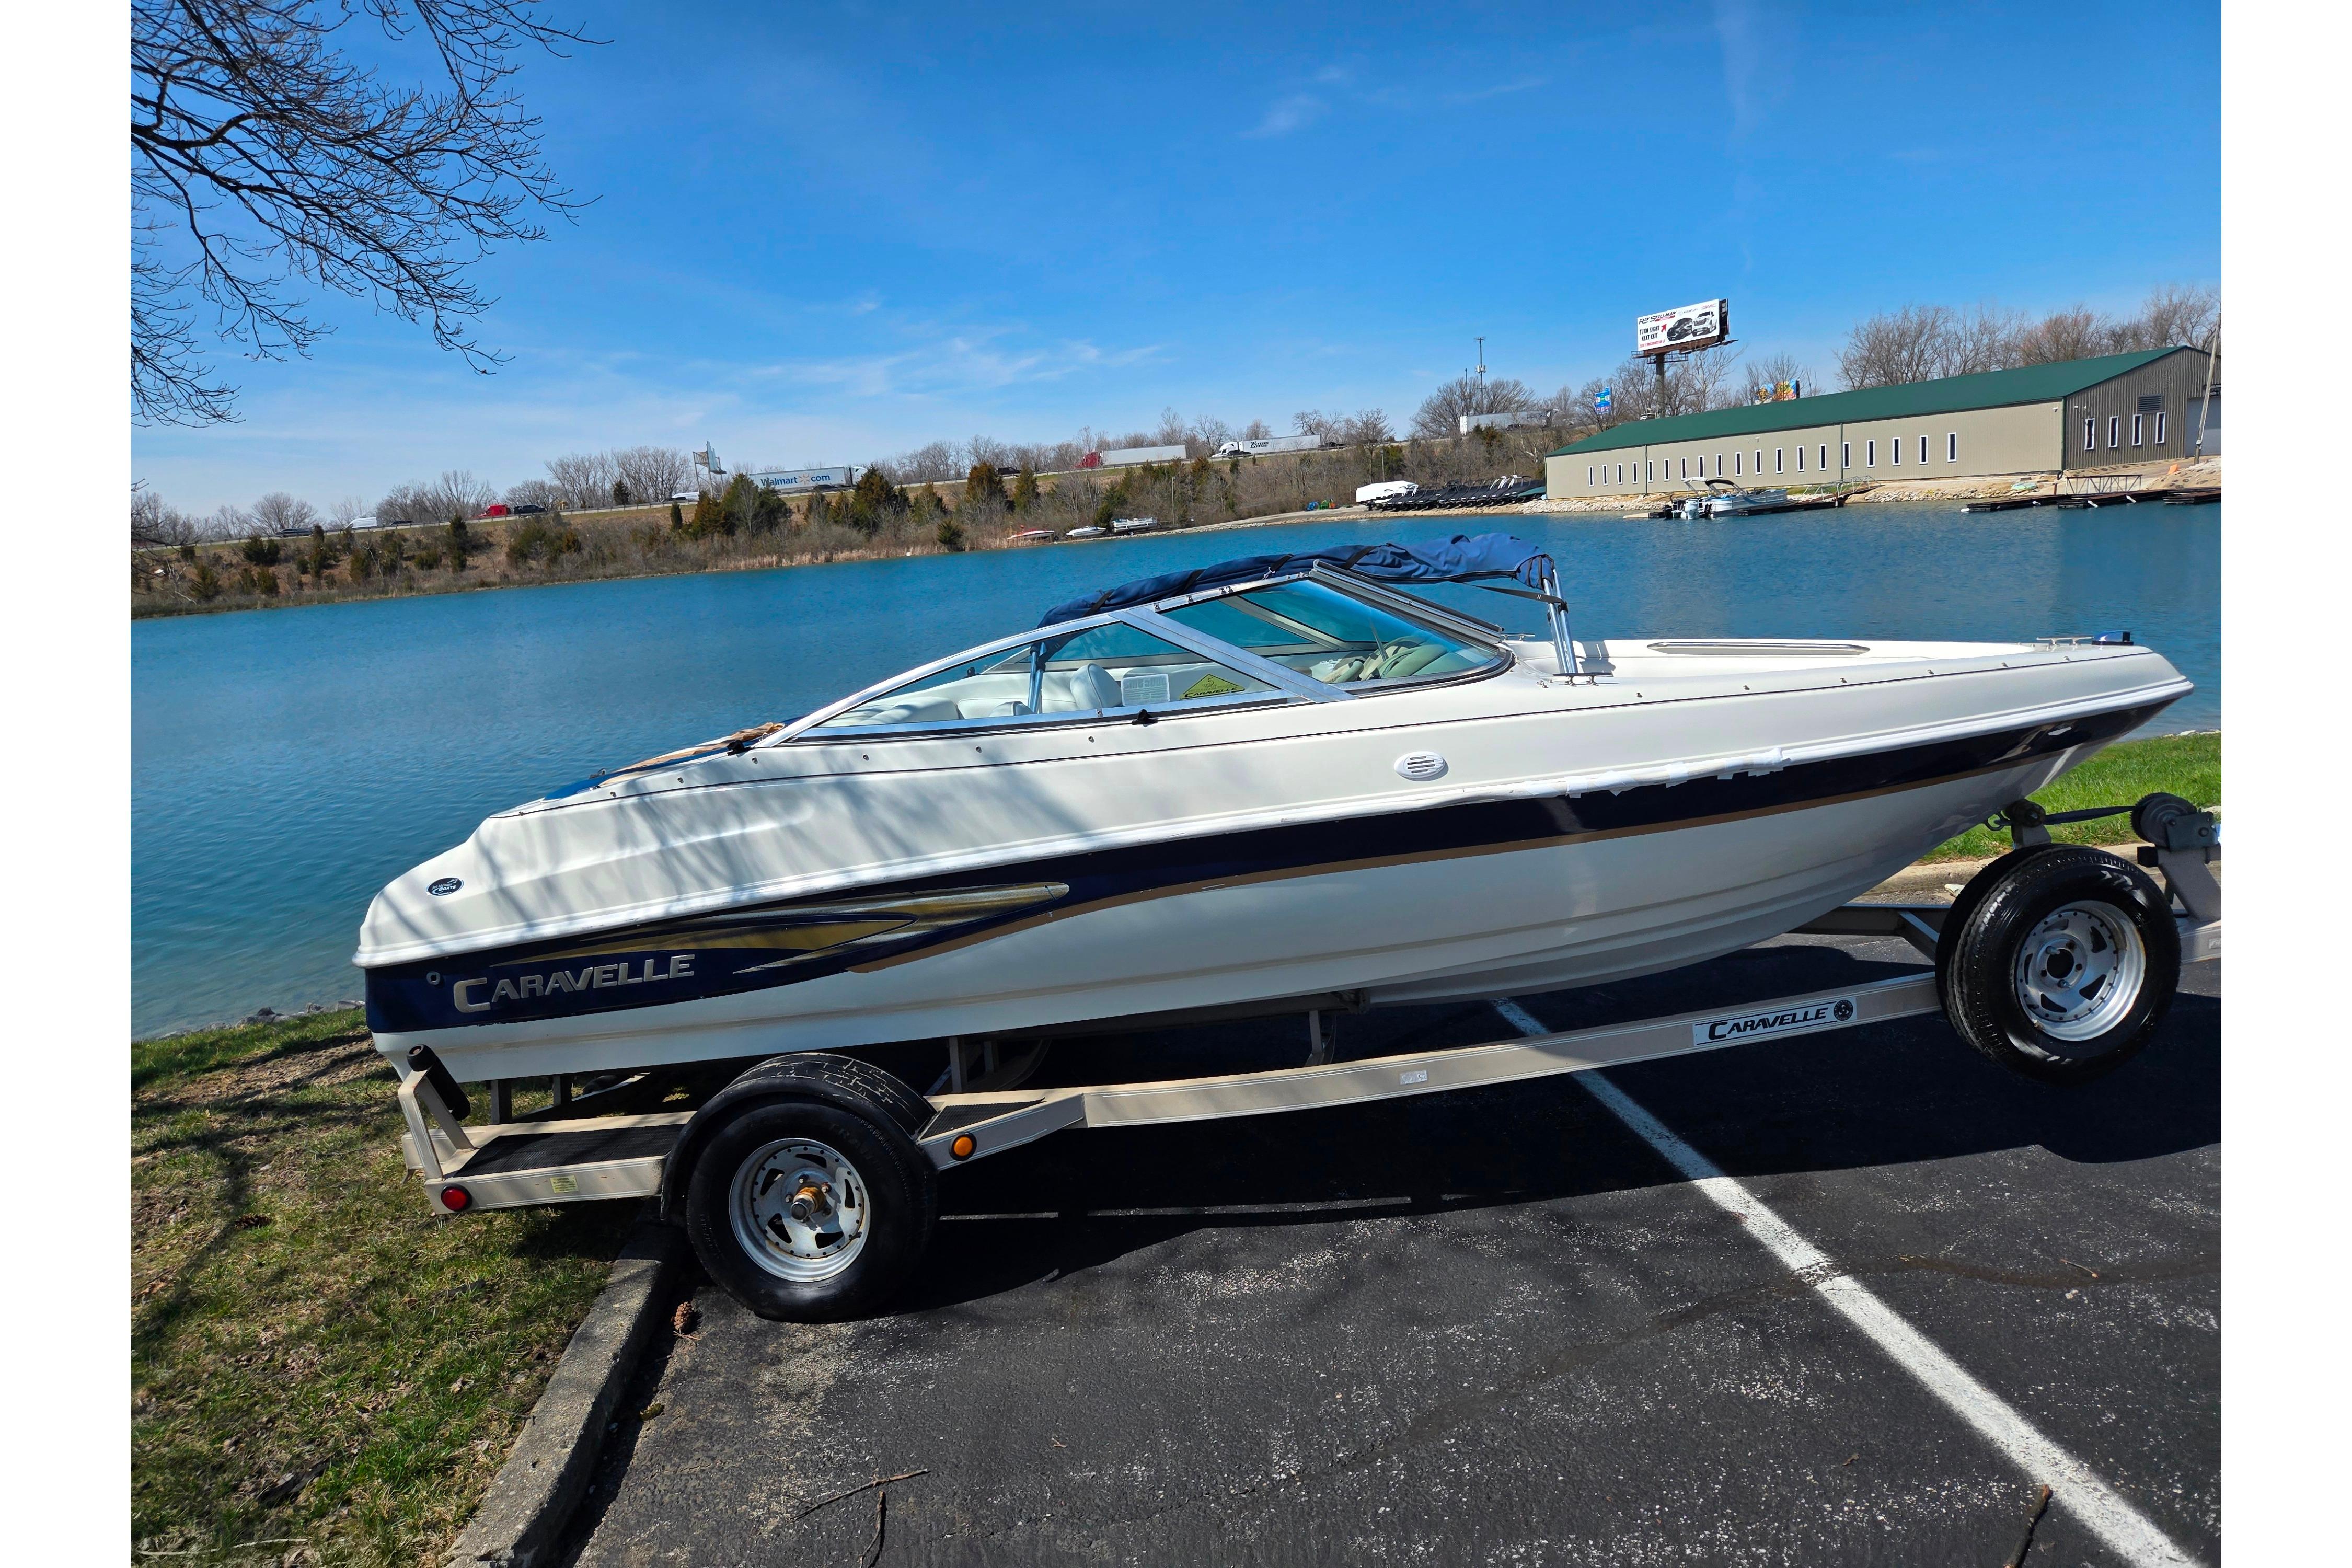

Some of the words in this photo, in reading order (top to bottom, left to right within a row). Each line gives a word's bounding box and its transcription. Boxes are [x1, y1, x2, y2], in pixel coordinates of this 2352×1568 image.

[1650, 311, 1677, 322] SKILLMAN
[760, 476, 798, 486] Walmart
[1184, 687, 1238, 698] CARAVELLE
[453, 954, 695, 1013] CARAVELLE
[1708, 1007, 1829, 1040] CARAVELLE
